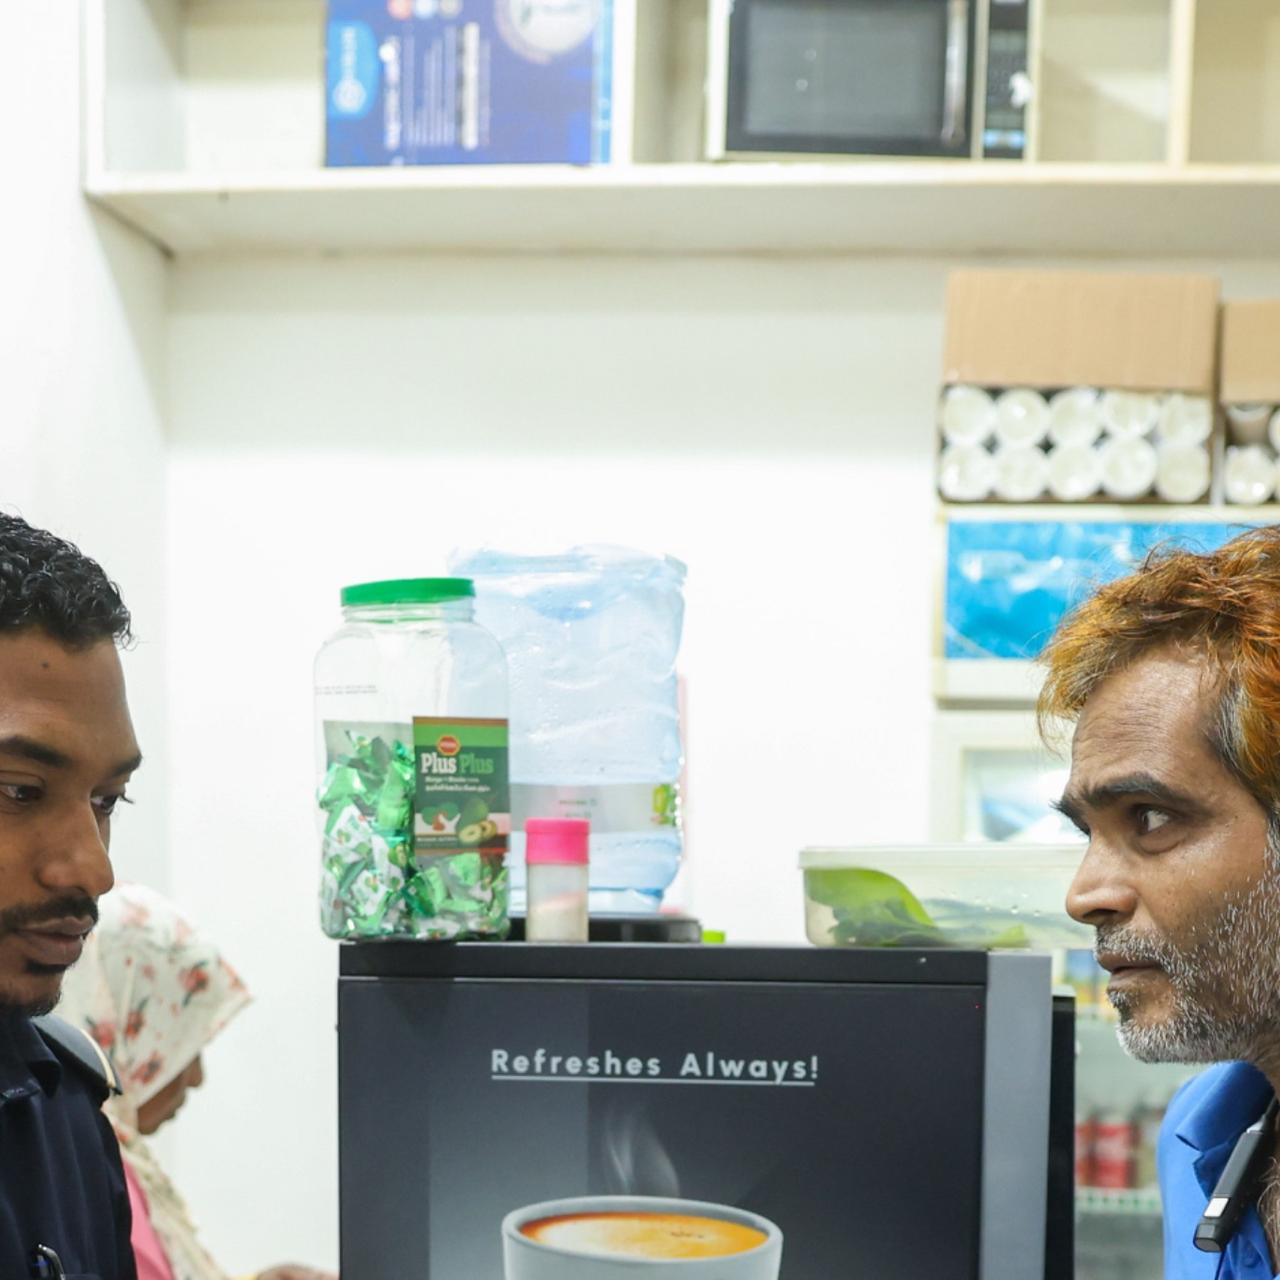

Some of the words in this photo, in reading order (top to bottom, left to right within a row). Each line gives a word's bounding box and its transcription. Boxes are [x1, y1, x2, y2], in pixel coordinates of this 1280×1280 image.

[421, 752, 457, 774] Plus
[460, 754, 495, 775] Plus
[491, 1049, 662, 1076] Refreshes
[680, 1052, 819, 1084] Always!
